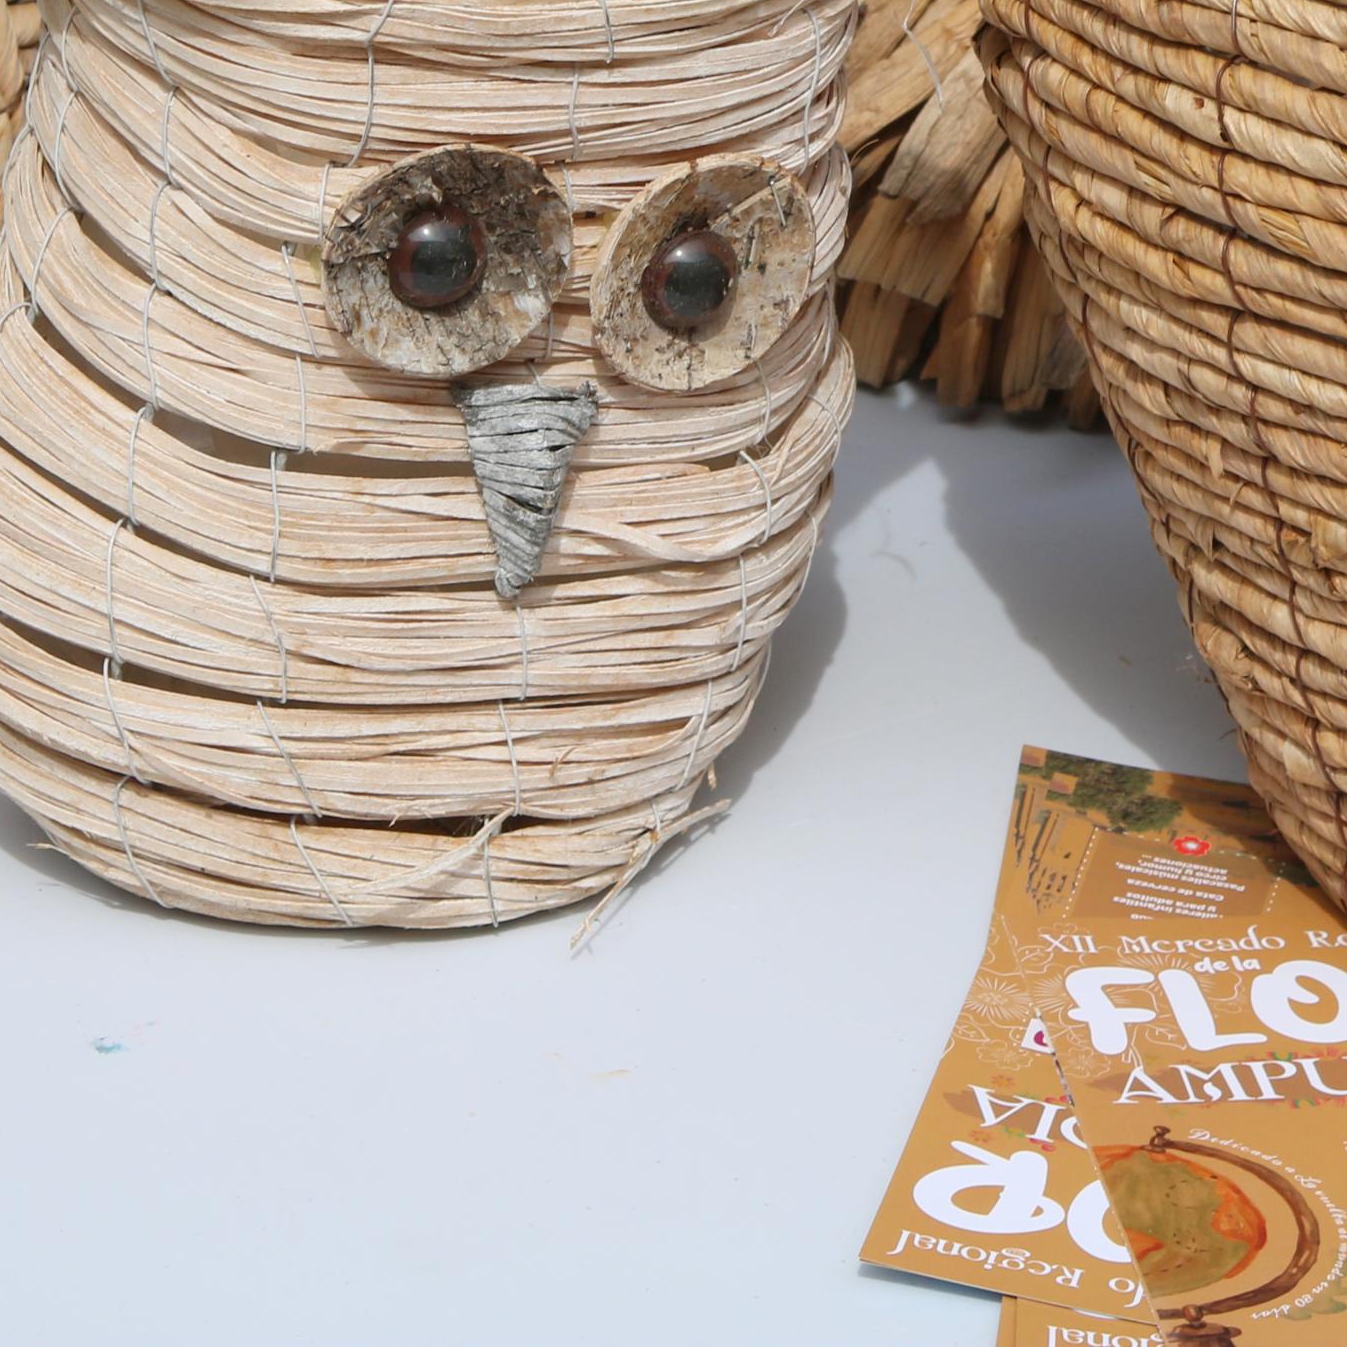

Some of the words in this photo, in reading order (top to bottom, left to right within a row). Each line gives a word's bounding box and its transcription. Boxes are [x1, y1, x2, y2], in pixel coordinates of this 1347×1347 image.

[1153, 856, 1228, 874] actuaciones
[1181, 875, 1245, 892] Pasacalles
[1195, 871, 1228, 882] circo
[1127, 878, 1176, 892] cerveza
[1177, 887, 1193, 896] de
[1126, 892, 1174, 905] adultos
[1195, 891, 1224, 901] Cata
[1113, 896, 1172, 913] infantiles
[1176, 900, 1206, 911] para
[1175, 908, 1224, 919] alleres
[1039, 934, 1098, 953] XII
[1118, 925, 1286, 954] Mercado
[1193, 956, 1229, 974] de
[1232, 956, 1260, 972] la
[1187, 1128, 1283, 1167] Dedicado
[1294, 1293, 1314, 1307] 80
[886, 1229, 1085, 1289] Regional
